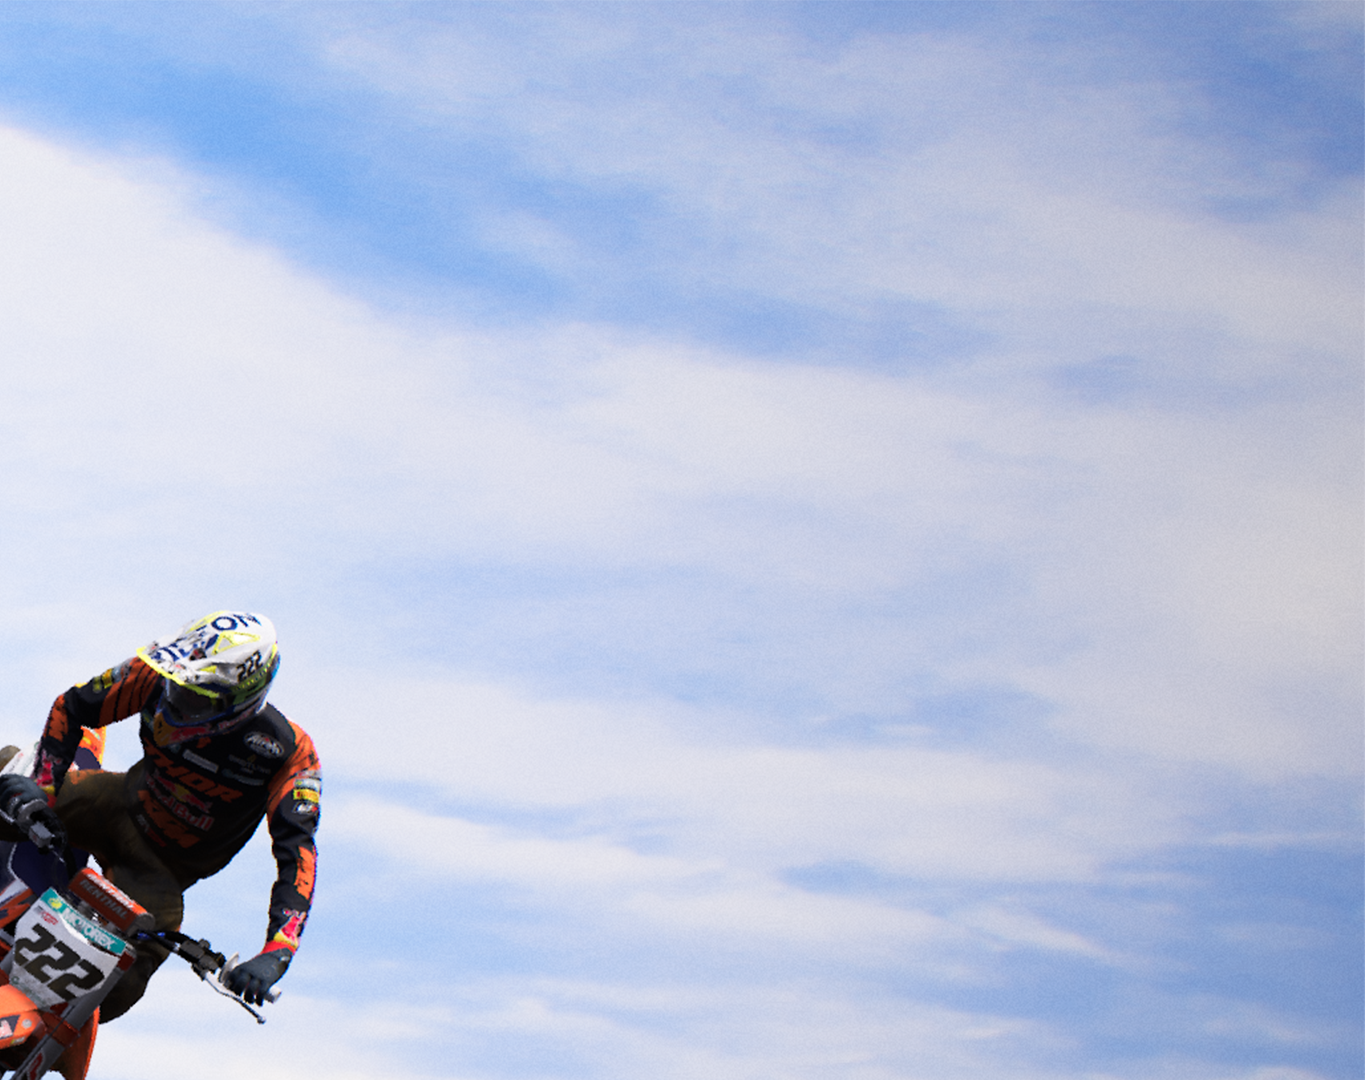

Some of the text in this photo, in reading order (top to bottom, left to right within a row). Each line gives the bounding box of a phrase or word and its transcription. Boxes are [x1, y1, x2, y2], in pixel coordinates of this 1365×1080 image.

[235, 650, 264, 682] 222
[173, 803, 216, 832] Bull
[79, 879, 130, 920] RENTHAL
[63, 907, 117, 951] MOTOREX
[15, 922, 105, 1001] 222
